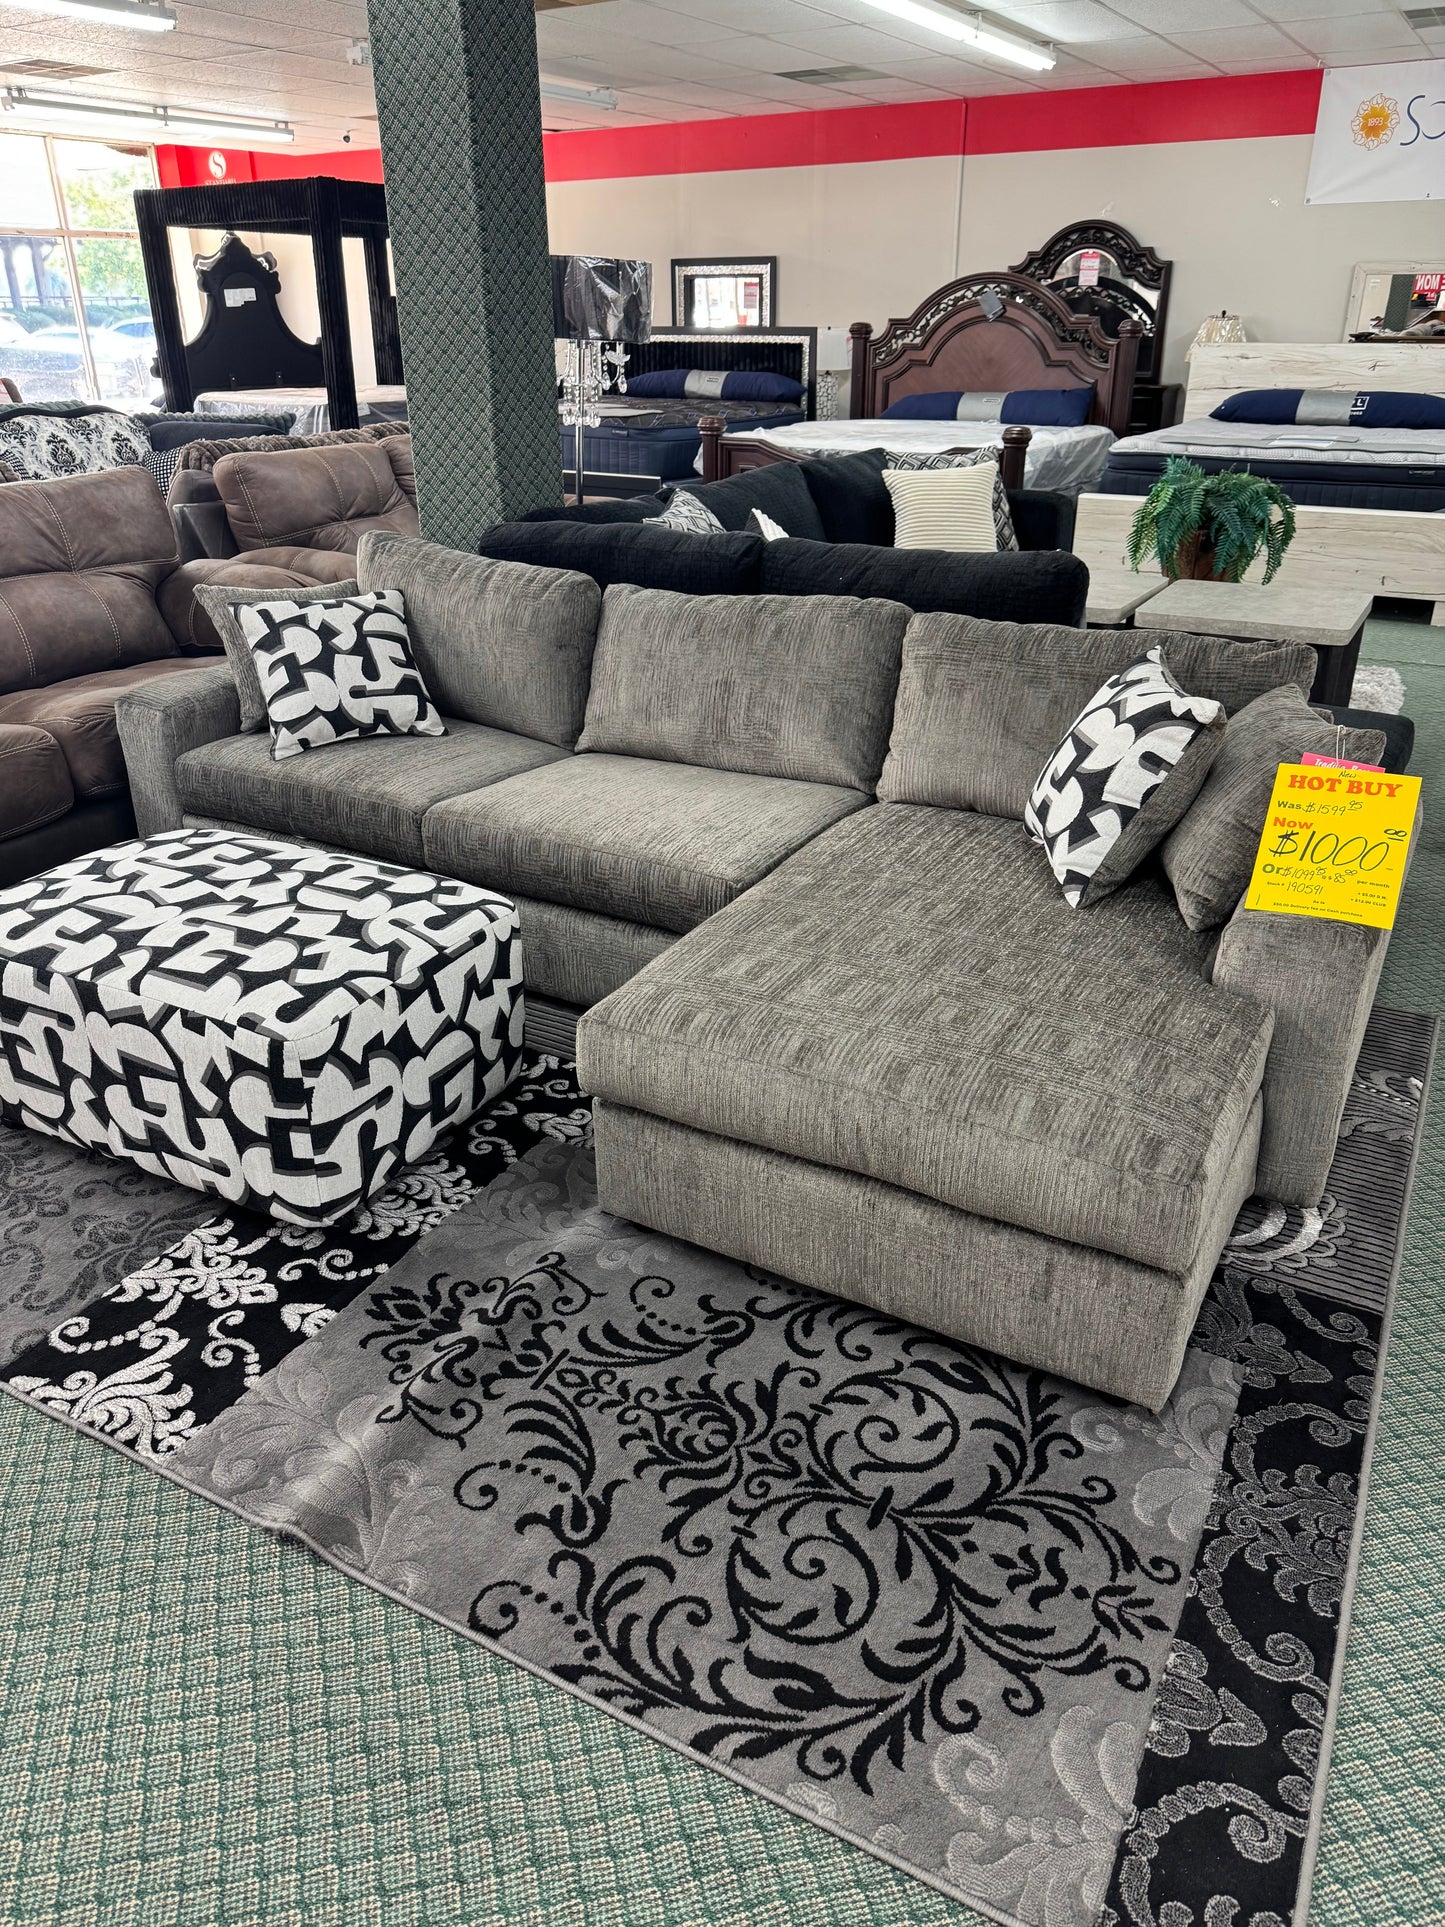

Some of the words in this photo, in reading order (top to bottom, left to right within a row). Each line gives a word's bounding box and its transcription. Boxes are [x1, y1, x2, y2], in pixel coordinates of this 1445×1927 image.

[1367, 117, 1384, 127] 1893
[1288, 774, 1342, 793] HOT
[1346, 779, 1403, 798] BUY
[1277, 800, 1302, 810] Was
[1273, 816, 1314, 830] Now
[1268, 829, 1389, 872] $1000
[1262, 863, 1283, 874] Or
[1369, 881, 1390, 889] month
[1286, 881, 1324, 895] 190591
